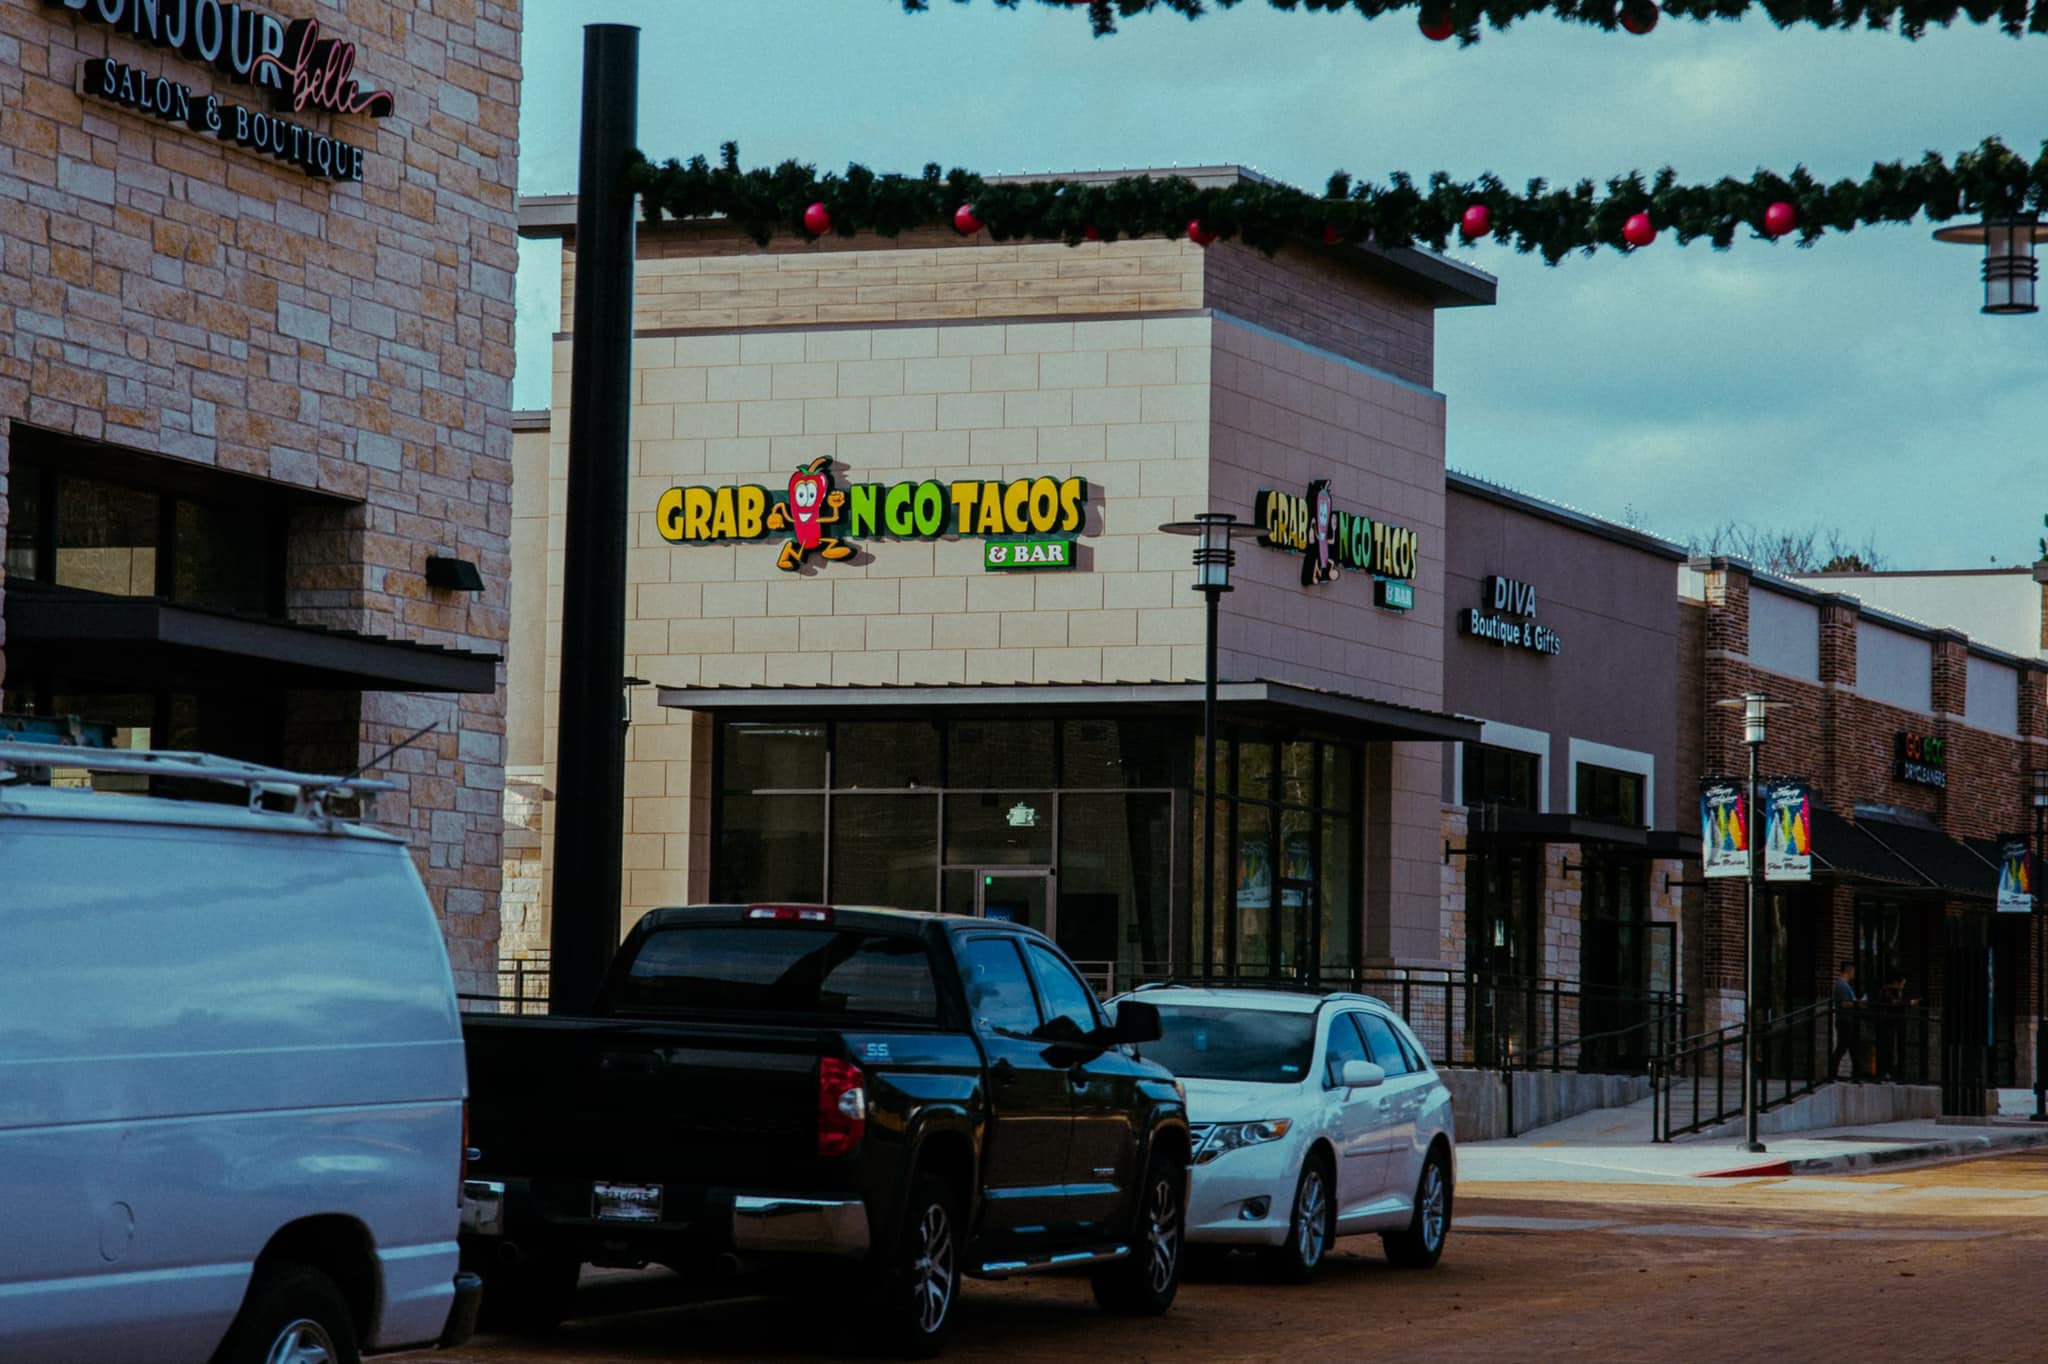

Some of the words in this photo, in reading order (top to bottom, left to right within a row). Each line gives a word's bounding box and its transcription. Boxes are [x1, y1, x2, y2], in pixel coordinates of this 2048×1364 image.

[63, 0, 283, 89] NJOUR
[251, 18, 394, 117] belle
[103, 57, 192, 121] SALON
[205, 95, 222, 131] &
[236, 105, 364, 182] BOUTIQUE
[656, 484, 765, 542] GRAB
[951, 476, 1082, 535] TACOS
[1266, 490, 1309, 550] GRAB
[1374, 521, 1418, 580] TACOS
[987, 545, 1007, 564] &
[1013, 544, 1065, 563] BAR
[1471, 608, 1520, 648] Boutique
[1523, 622, 1532, 648] &
[1534, 625, 1561, 656] Gifts
[1494, 576, 1537, 618] DIVA
